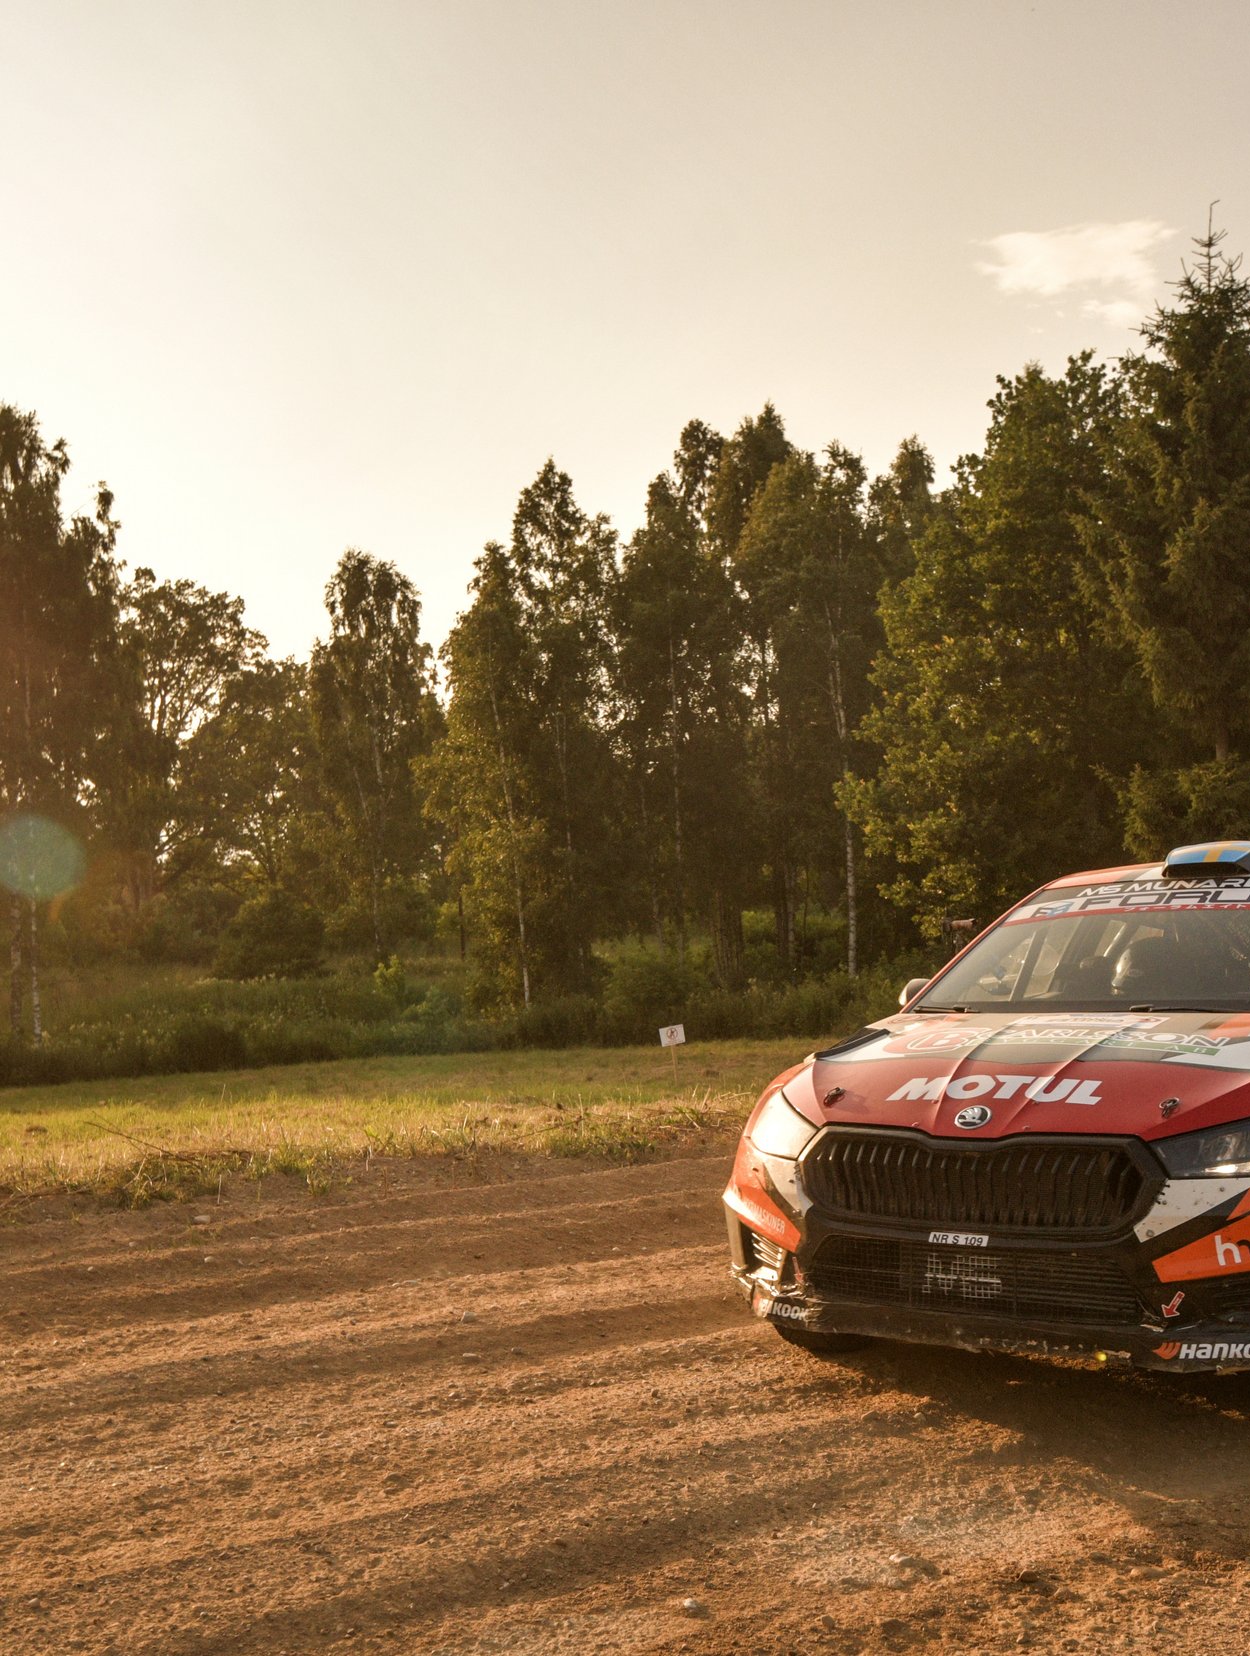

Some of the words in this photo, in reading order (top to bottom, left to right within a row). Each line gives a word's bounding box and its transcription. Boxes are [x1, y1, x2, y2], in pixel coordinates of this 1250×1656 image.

[1077, 884, 1124, 898] MS
[885, 1074, 1103, 1106] MOTUL
[932, 1233, 949, 1243] NR
[952, 1235, 960, 1244] S
[964, 1236, 984, 1246] 109
